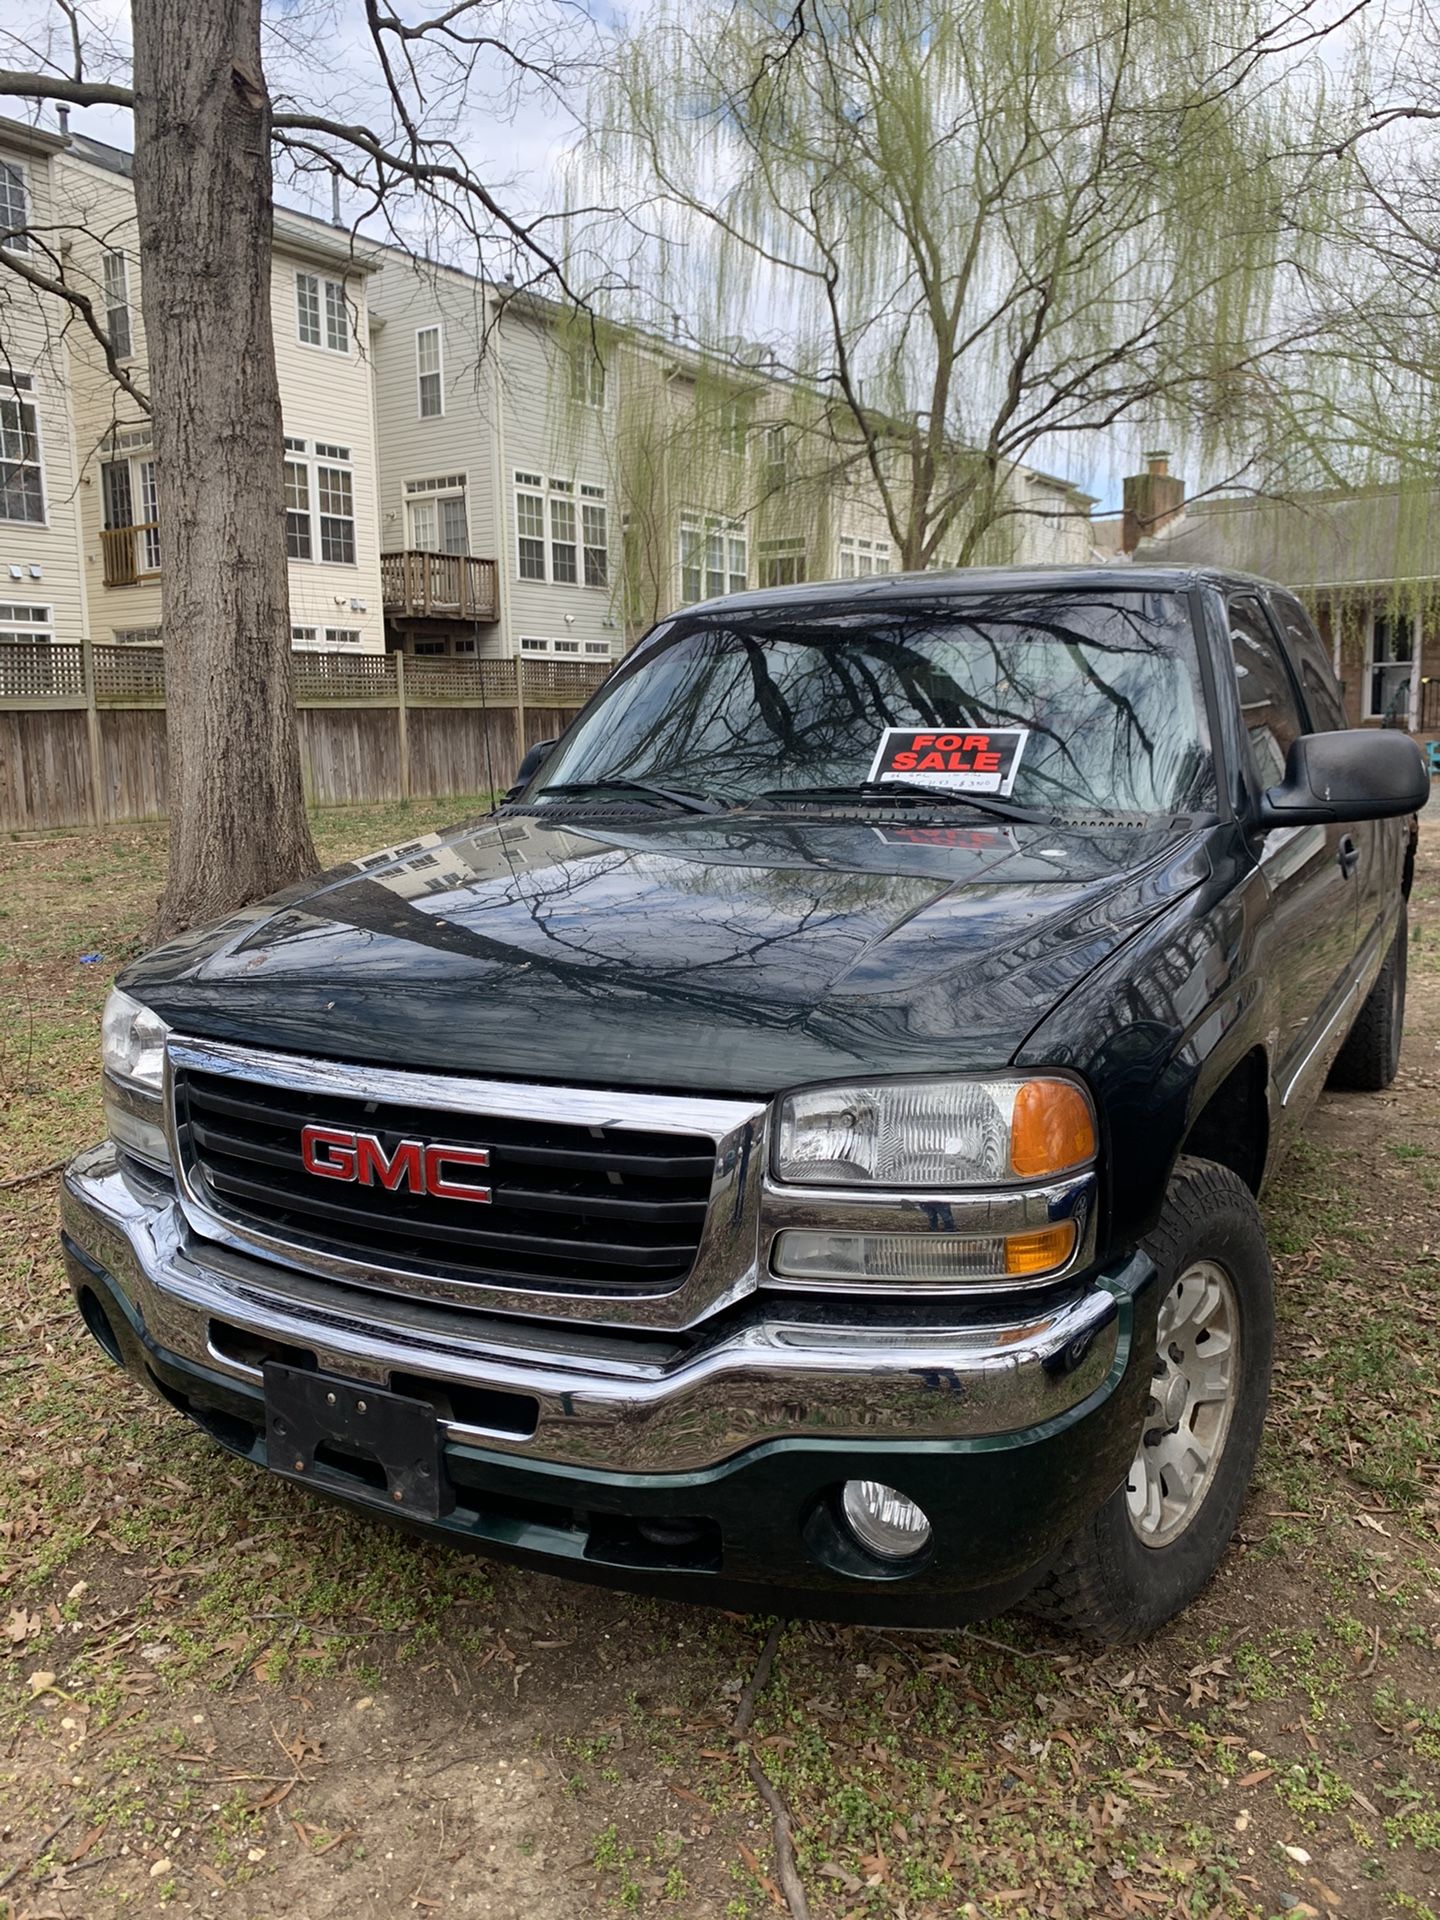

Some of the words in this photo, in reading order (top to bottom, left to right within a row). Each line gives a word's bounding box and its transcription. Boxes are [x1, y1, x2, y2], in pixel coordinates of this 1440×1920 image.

[911, 735, 990, 751] FOR
[891, 752, 1002, 771] SALE
[301, 1124, 492, 1204] GMC
